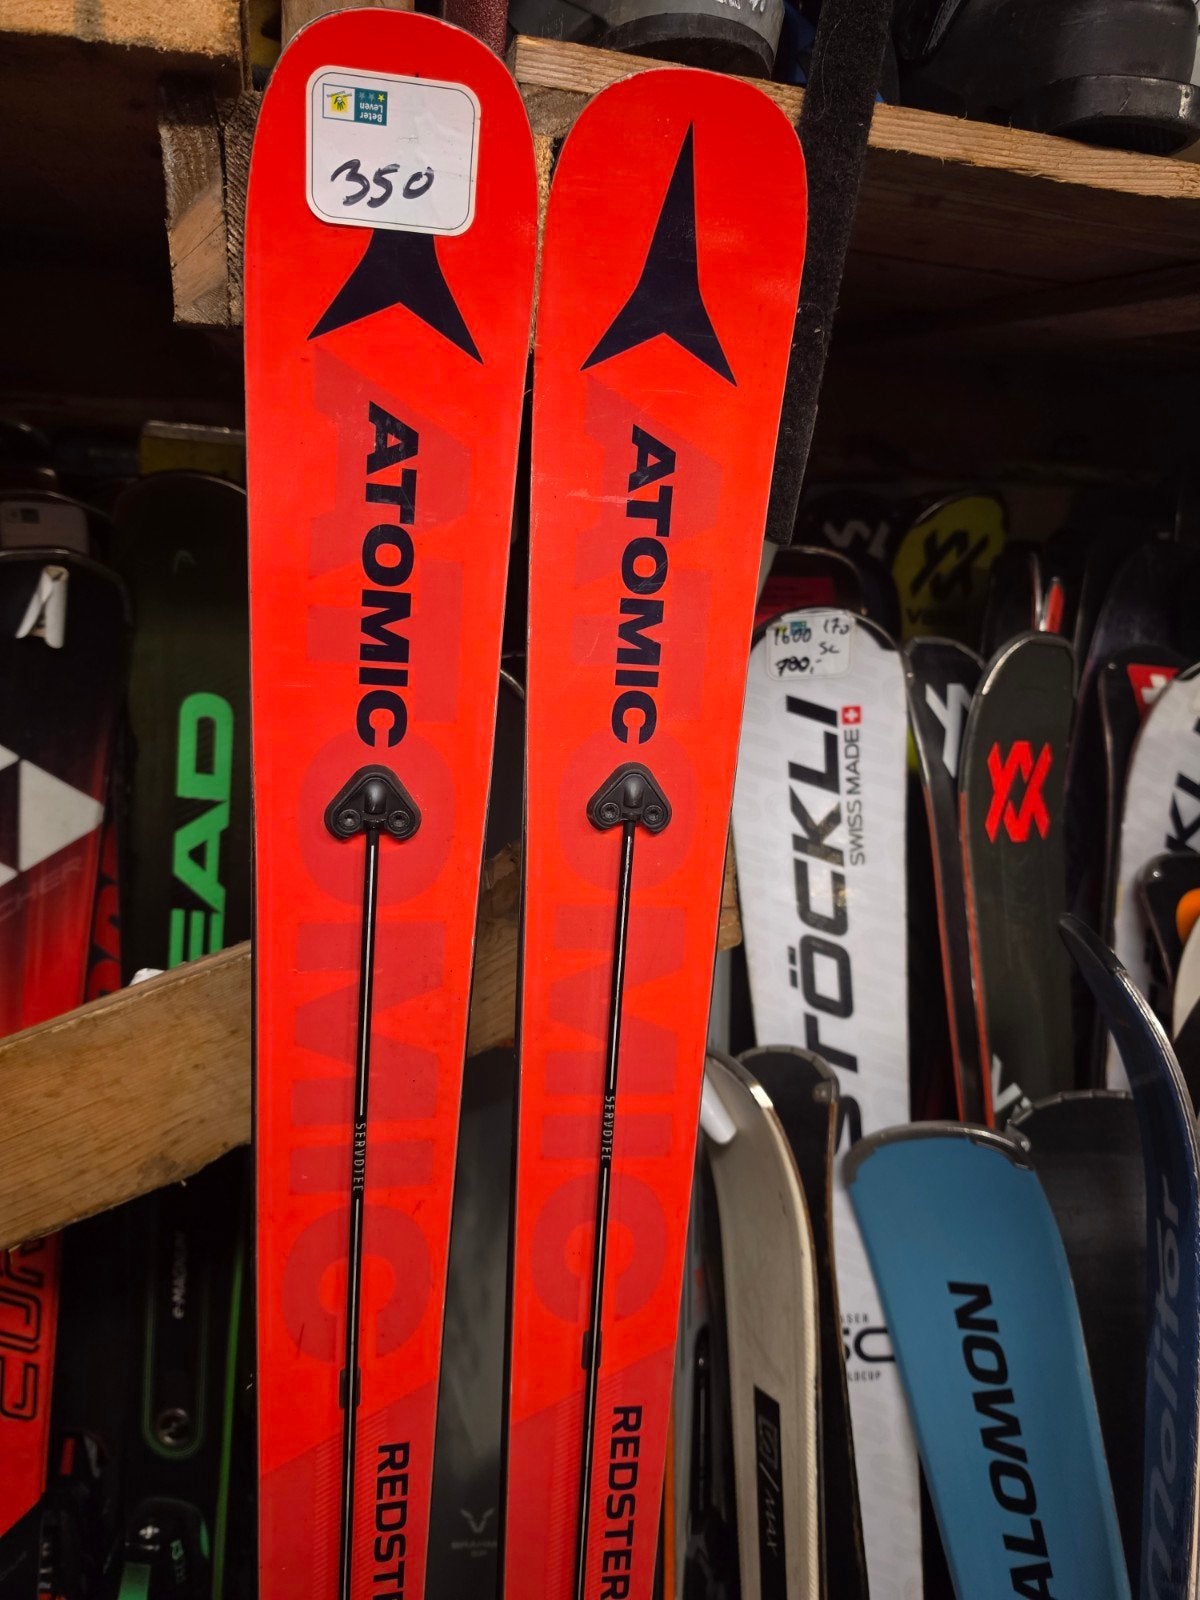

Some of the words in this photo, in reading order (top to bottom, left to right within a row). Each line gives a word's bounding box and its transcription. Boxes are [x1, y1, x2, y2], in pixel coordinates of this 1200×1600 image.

[359, 102, 384, 114] Leven
[359, 112, 383, 123] Beter
[330, 158, 435, 208] 350
[356, 401, 419, 748] ATOMIC
[611, 424, 677, 745] ATOMIC
[843, 728, 861, 796] MADE
[846, 799, 866, 867] SWISS
[352, 1122, 367, 1192] SERVOTEC
[601, 1095, 616, 1161] SERVOTEC
[600, 1405, 643, 1600] REDSTER
